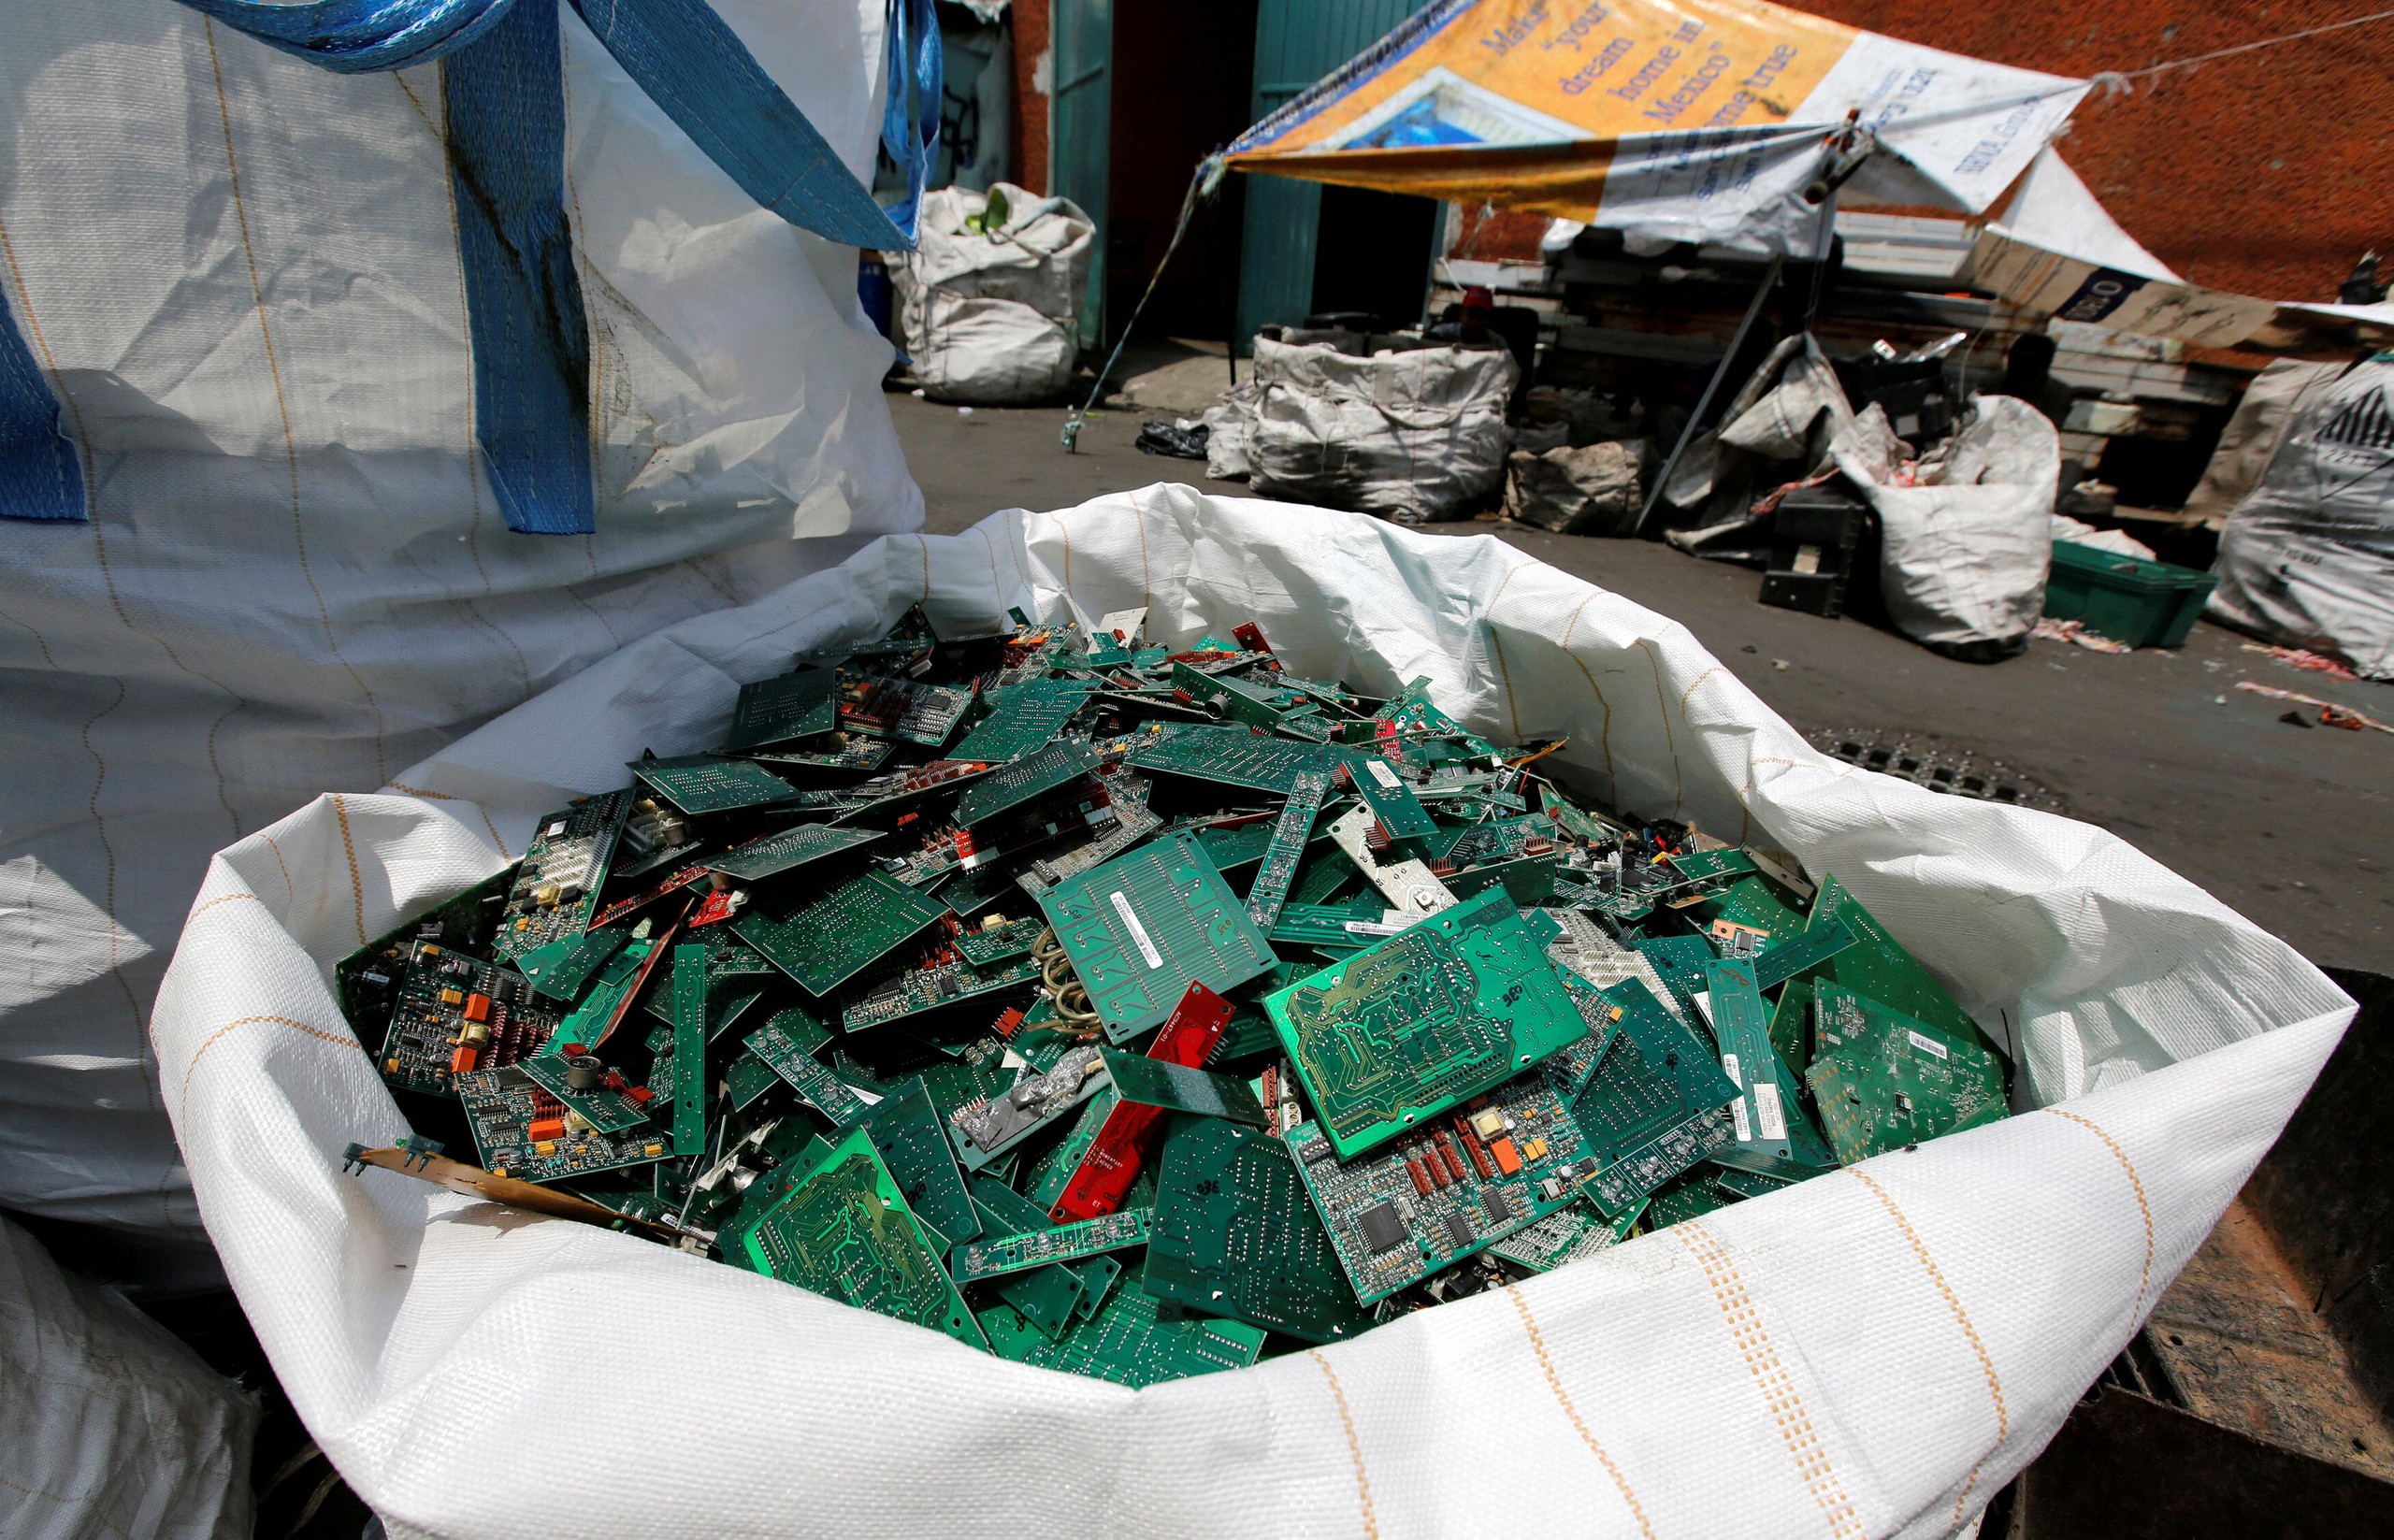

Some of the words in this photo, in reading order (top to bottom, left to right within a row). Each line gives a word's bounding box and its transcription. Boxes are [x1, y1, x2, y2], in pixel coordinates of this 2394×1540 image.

[1559, 37, 1635, 95] dream
[1607, 46, 1681, 102] home
[1666, 20, 1705, 44] in
[1744, 44, 1798, 89] true
